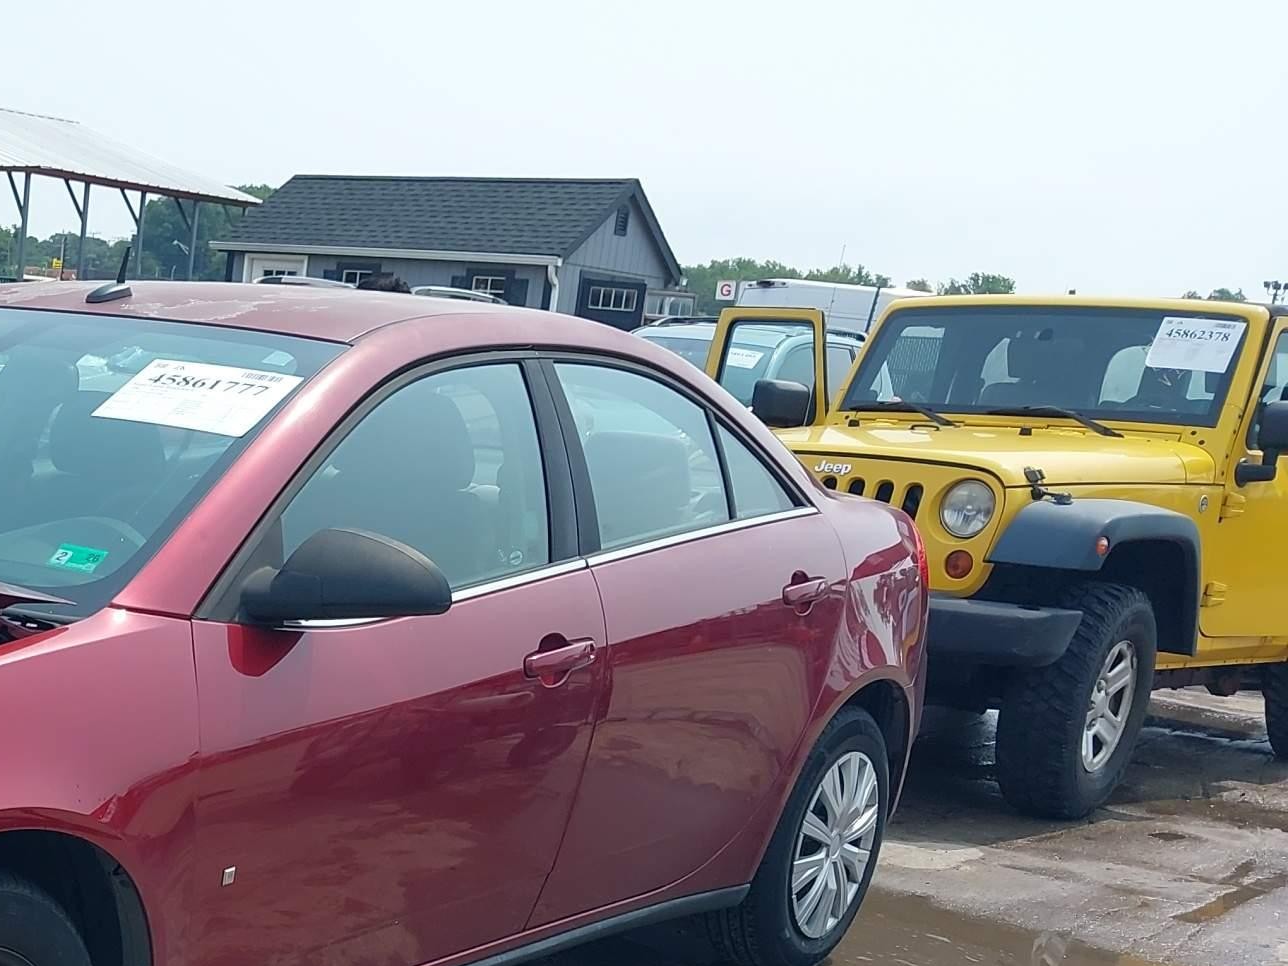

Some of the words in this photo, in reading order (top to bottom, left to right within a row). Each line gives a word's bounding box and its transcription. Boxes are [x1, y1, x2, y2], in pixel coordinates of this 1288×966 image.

[720, 283, 732, 297] G
[1166, 328, 1231, 342] 45862378
[148, 373, 270, 397] 45861777
[814, 460, 852, 476] Jeep
[56, 551, 68, 562] 2
